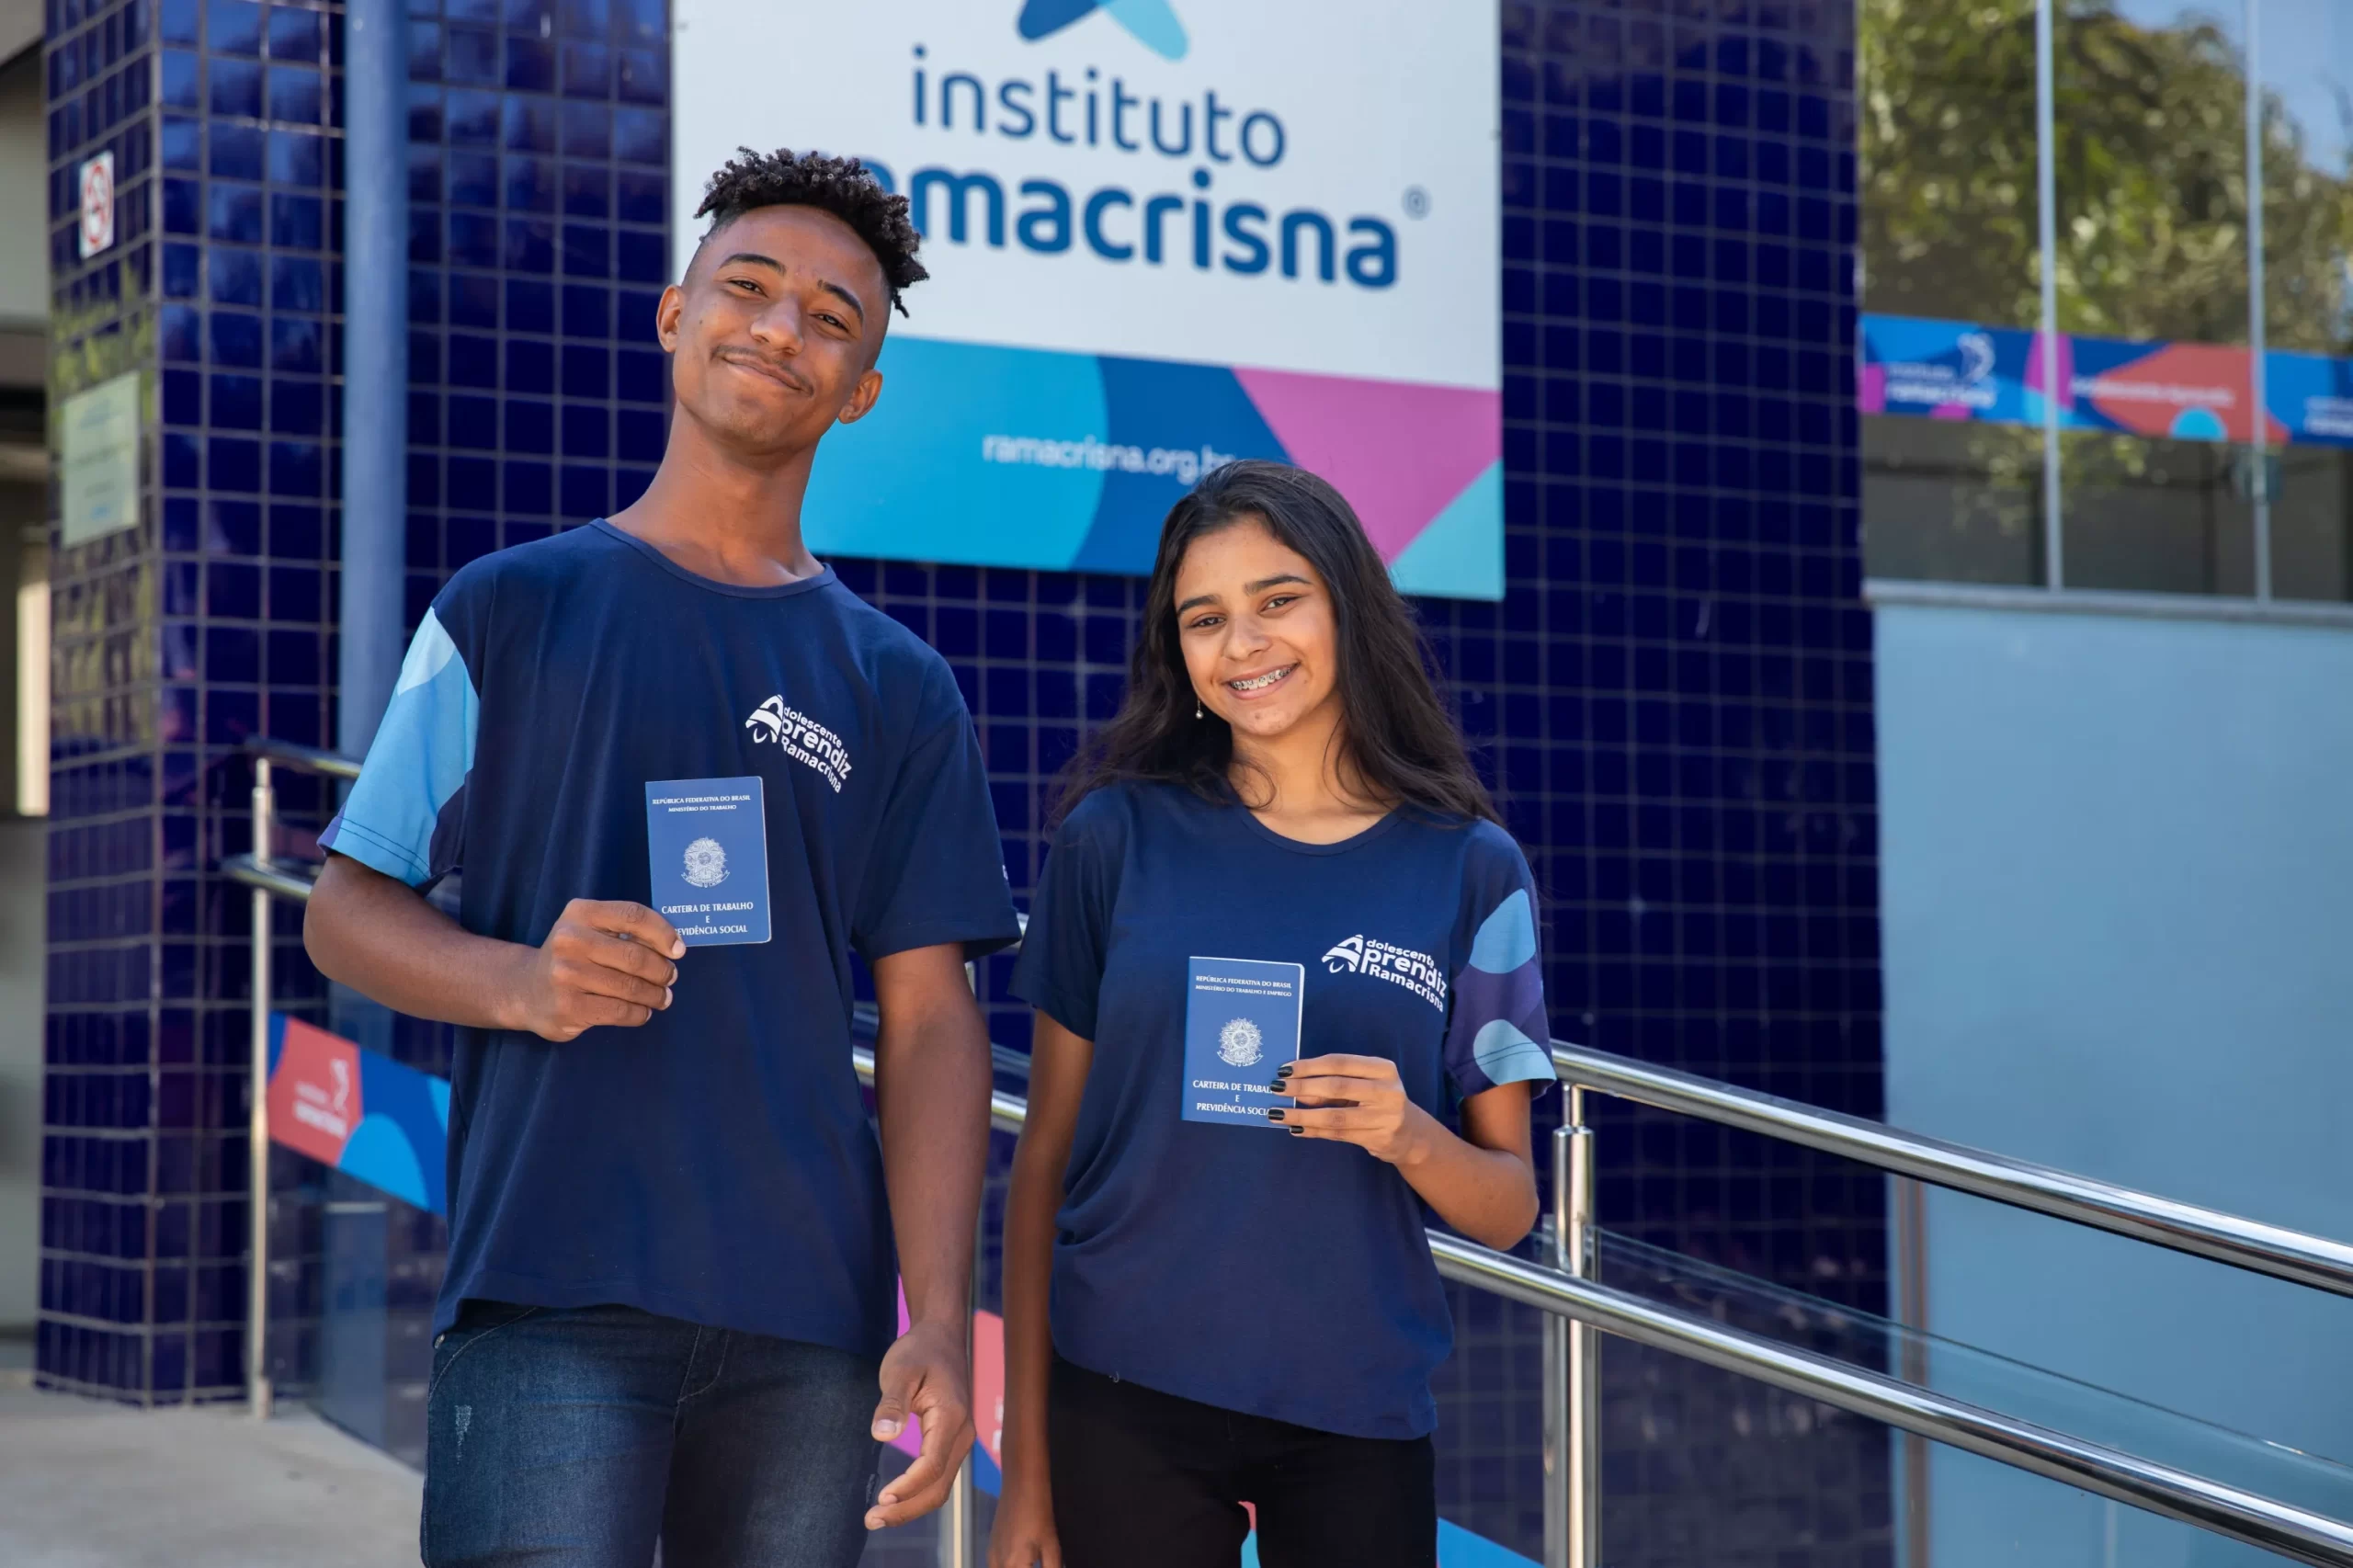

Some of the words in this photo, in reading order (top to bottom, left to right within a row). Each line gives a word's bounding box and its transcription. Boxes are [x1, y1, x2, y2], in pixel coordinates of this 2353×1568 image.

[913, 43, 1285, 168] instituto
[858, 158, 1399, 290] macrisna
[781, 735, 842, 793] Ramacrisna
[653, 797, 684, 805] REPÚBLICA
[662, 904, 699, 914] CARTEIRA
[711, 902, 754, 912] TRABALHO
[675, 925, 718, 936] EVIDÊNCIA
[719, 925, 748, 934] SOCIAL
[1196, 974, 1226, 983] REPÚBLICA
[1228, 978, 1261, 986] FEDERATIVA
[1369, 963, 1443, 1013] Ramacrisna
[1193, 1079, 1230, 1090] CARTEIRA
[1231, 1083, 1241, 1092] DE
[1243, 1084, 1272, 1094] TRABAL
[1235, 1094, 1241, 1103] E
[1197, 1103, 1246, 1114] PREVIDÊNCIA
[1247, 1107, 1269, 1116] SOCIA
